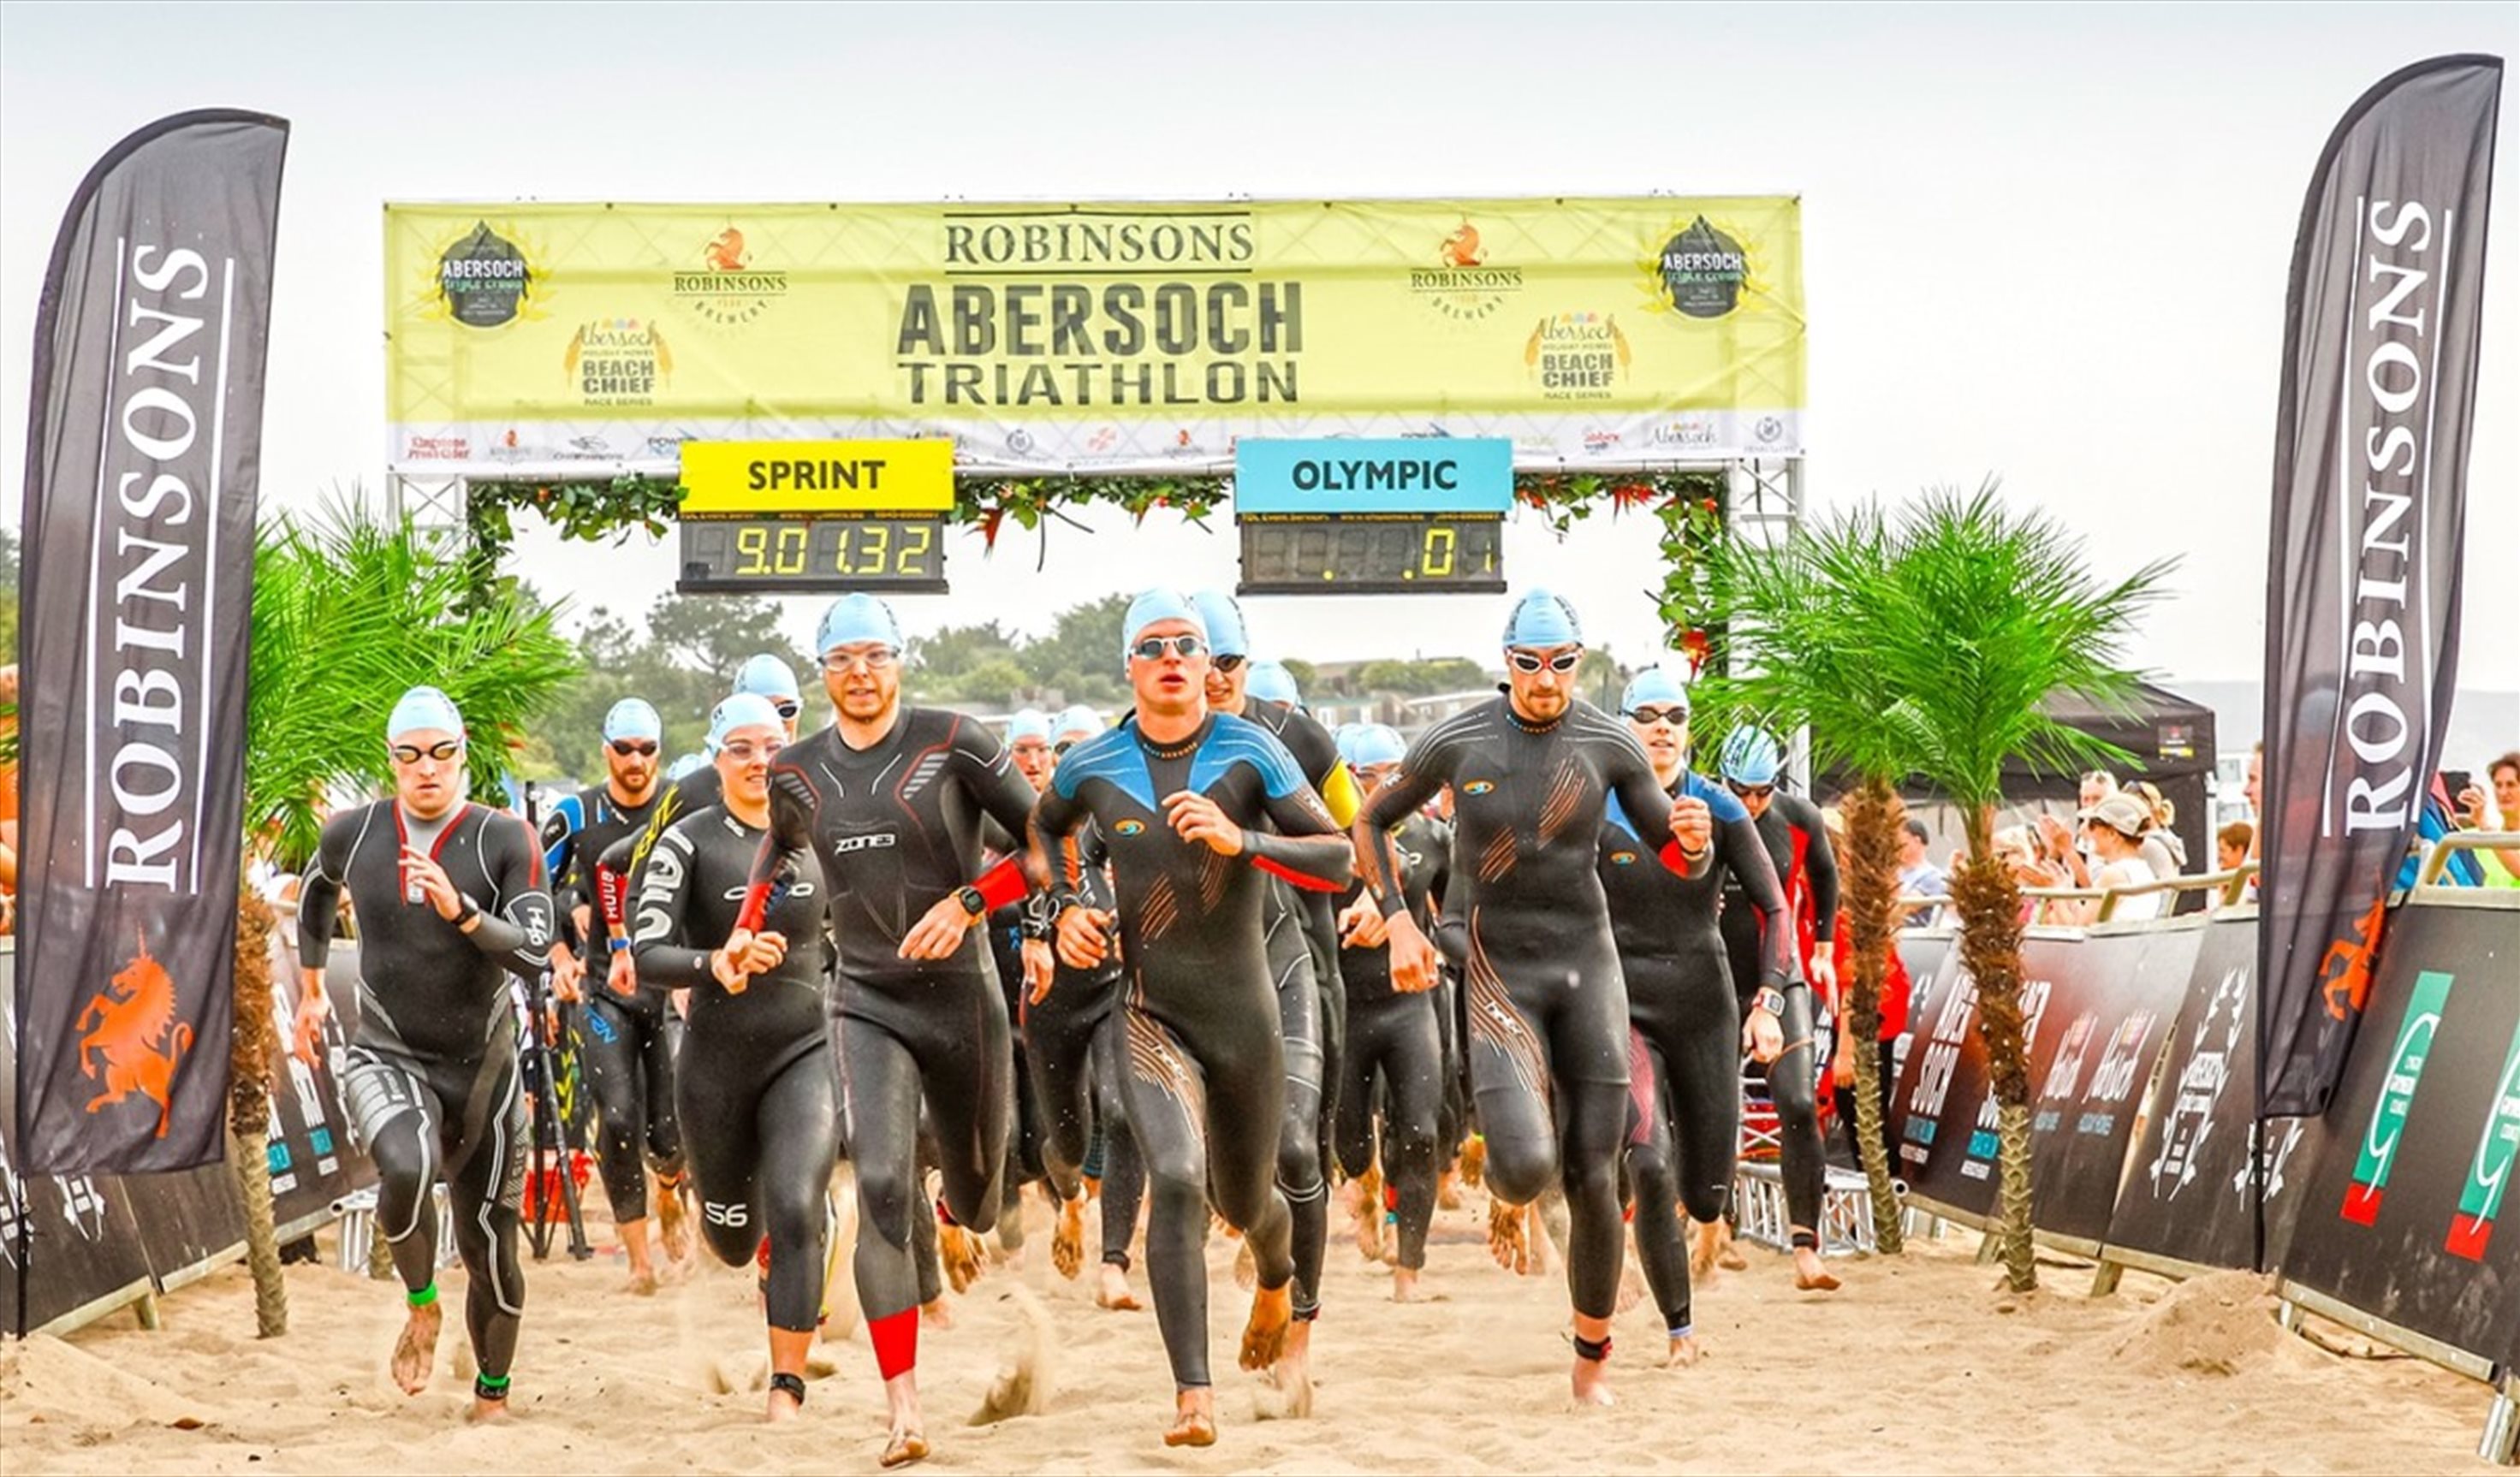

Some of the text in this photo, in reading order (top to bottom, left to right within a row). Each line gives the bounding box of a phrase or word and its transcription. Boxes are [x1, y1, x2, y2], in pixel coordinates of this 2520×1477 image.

[944, 223, 1253, 264] ROBINSONS
[442, 259, 523, 278] ABERSOCH
[1664, 253, 1742, 271] ABERSOCH
[675, 276, 788, 292] ROBINSONS
[1412, 271, 1522, 288] ROBINSONS
[897, 282, 1302, 357] ABERSOCH
[583, 359, 654, 377] BEACH
[1542, 353, 1613, 371] BEACH
[583, 377, 655, 394] CHIEF
[897, 360, 1299, 406] TRIATHLON
[1542, 371, 1614, 389] CHIEF
[748, 460, 886, 490] SPRINT
[1292, 460, 1459, 490] OLYMPIC
[2346, 201, 2431, 836] ROBINSONS
[106, 245, 209, 893] ROBINSONS
[705, 1201, 748, 1227] 56
